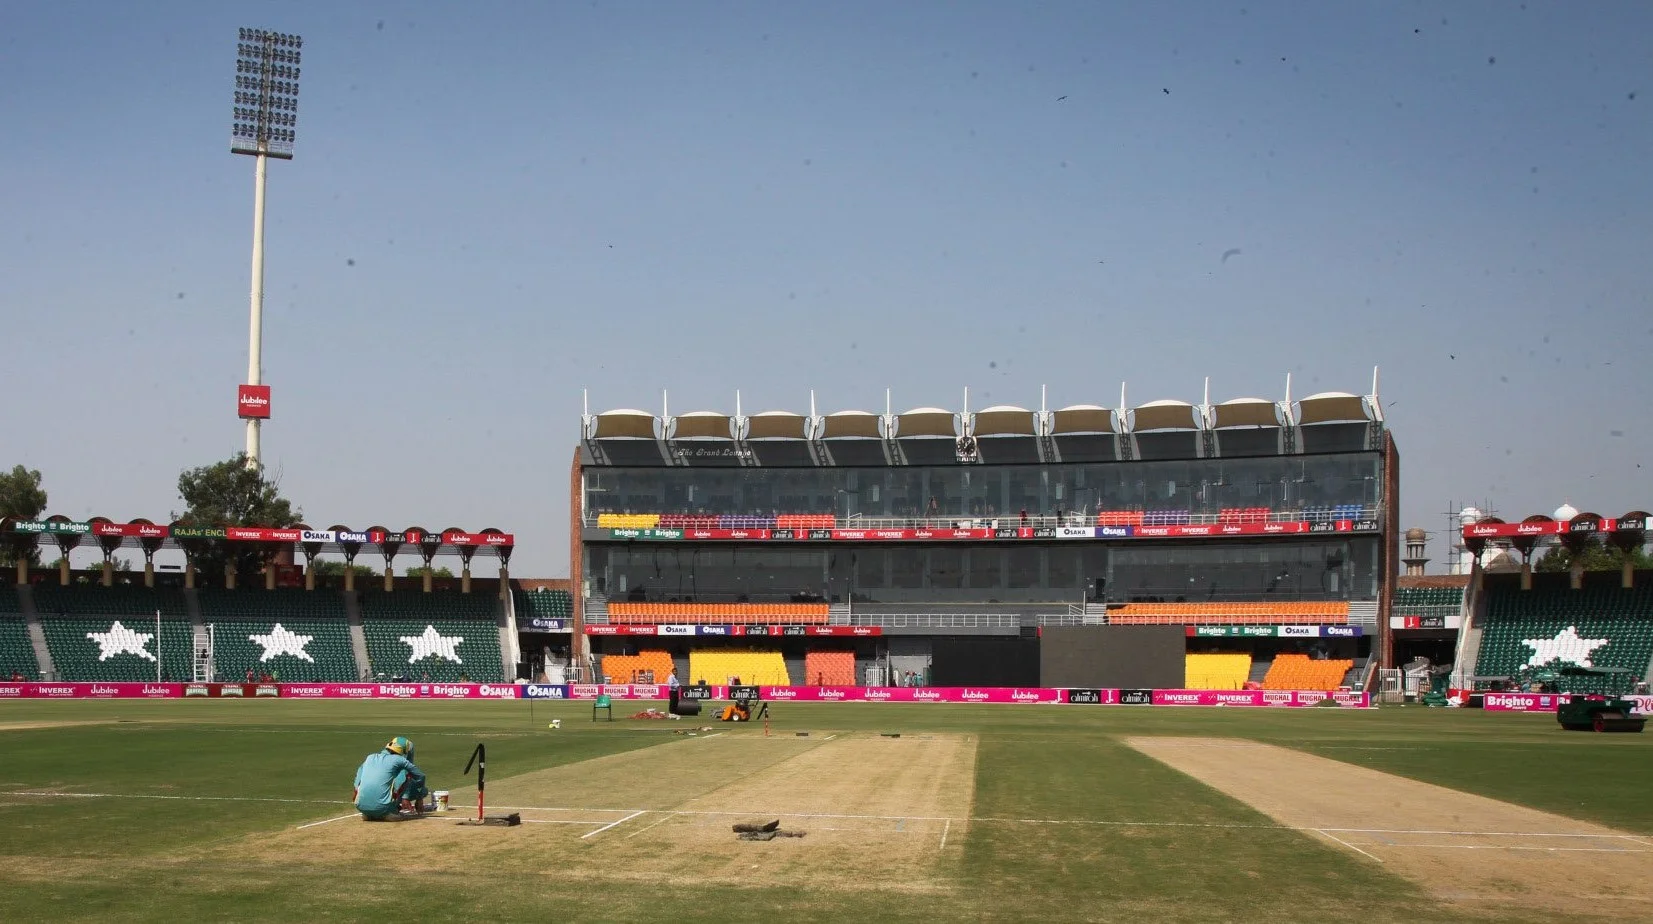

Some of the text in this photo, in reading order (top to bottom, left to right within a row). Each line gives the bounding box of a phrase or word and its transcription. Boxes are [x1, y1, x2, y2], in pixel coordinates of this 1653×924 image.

[240, 394, 268, 405] Jubilee
[16, 522, 46, 533] Brighto
[60, 523, 89, 534] Brighto
[102, 524, 123, 533] Jubilee
[140, 525, 161, 534] Jubilee
[1064, 528, 1086, 536] OSAKA
[1103, 528, 1125, 536] OSAKA
[1223, 524, 1241, 532] Jubilee
[1473, 525, 1497, 534] Jubilee
[1517, 524, 1542, 533] Jubilee
[205, 529, 227, 537] ENCL
[304, 531, 330, 540] OSAKA
[340, 532, 367, 541] OSAKA
[615, 529, 640, 538] Brighto
[655, 529, 680, 538] Brighto
[451, 534, 471, 542] Jubilee
[486, 535, 506, 543] Jubilee
[533, 618, 559, 628] OSAKA
[666, 626, 687, 634] OSAKA
[702, 626, 725, 634] OSAKA
[1198, 627, 1226, 635] Brighto
[1244, 627, 1272, 635] Brighto
[1285, 627, 1309, 635] OSAKA
[1327, 627, 1353, 635] OSAKA
[39, 686, 73, 694] INVEREX
[91, 684, 119, 694] Jubilee
[142, 684, 170, 694] Jubilee
[291, 686, 323, 694] INVEREX
[340, 686, 373, 694] INVEREX
[380, 685, 416, 697] Brighto
[433, 685, 470, 697] Brighto
[480, 685, 515, 697] OSAKA
[528, 685, 562, 697] OSAKA
[770, 687, 796, 697] Jubilee
[818, 687, 845, 698] Jubilee
[864, 687, 891, 698] Jubilee
[913, 688, 940, 698] Jubilee
[962, 689, 989, 699] Jubilee
[1012, 689, 1039, 700] Jubilee
[1164, 693, 1198, 701] INVEREX
[1217, 693, 1252, 701] INVEREX
[1487, 695, 1533, 708] Brighto
